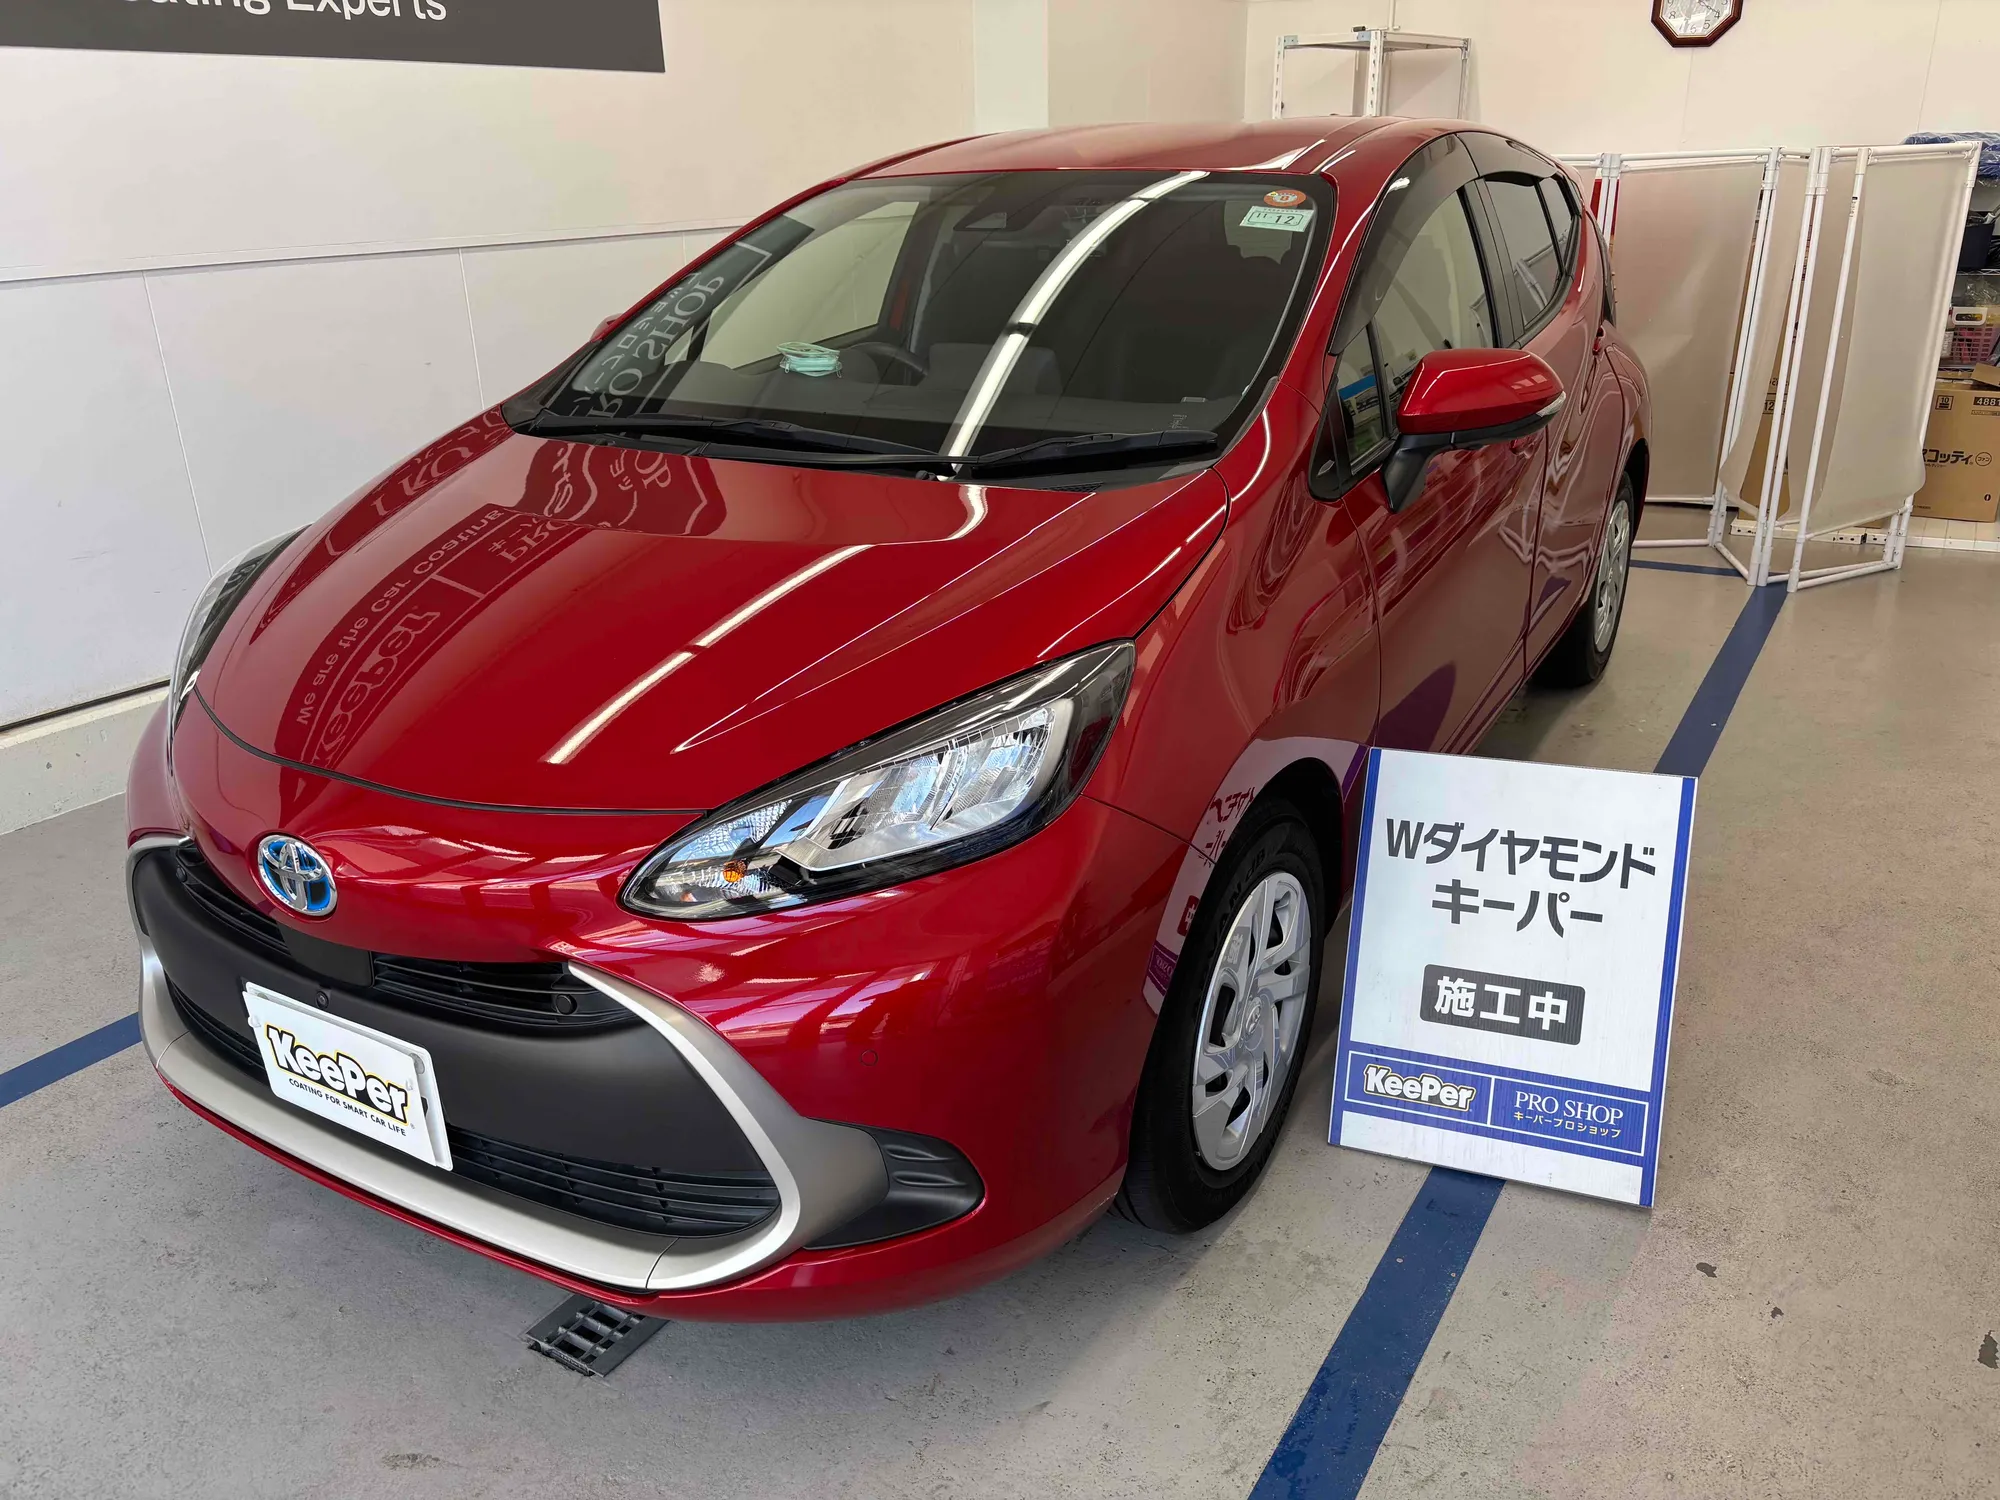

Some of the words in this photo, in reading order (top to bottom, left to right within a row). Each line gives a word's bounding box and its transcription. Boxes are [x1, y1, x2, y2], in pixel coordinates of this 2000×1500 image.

[1703, 20, 1711, 29] 5
[1275, 214, 1296, 225] 12
[1385, 817, 1656, 889] Wダイヤモンド
[1431, 878, 1603, 938] キーパー
[1434, 975, 1568, 1031] 施工中
[265, 1023, 409, 1125] KeePer
[1364, 1065, 1476, 1112] KeePer
[288, 1078, 323, 1098] COATING
[325, 1093, 341, 1105] FOR
[342, 1101, 368, 1119] SMART
[370, 1112, 387, 1127] CAR
[388, 1122, 406, 1136] LIFE
[1513, 1111, 1622, 1138] キーパープロショップ
[1514, 1090, 1559, 1115] PRO
[1563, 1099, 1624, 1126] SHOP
